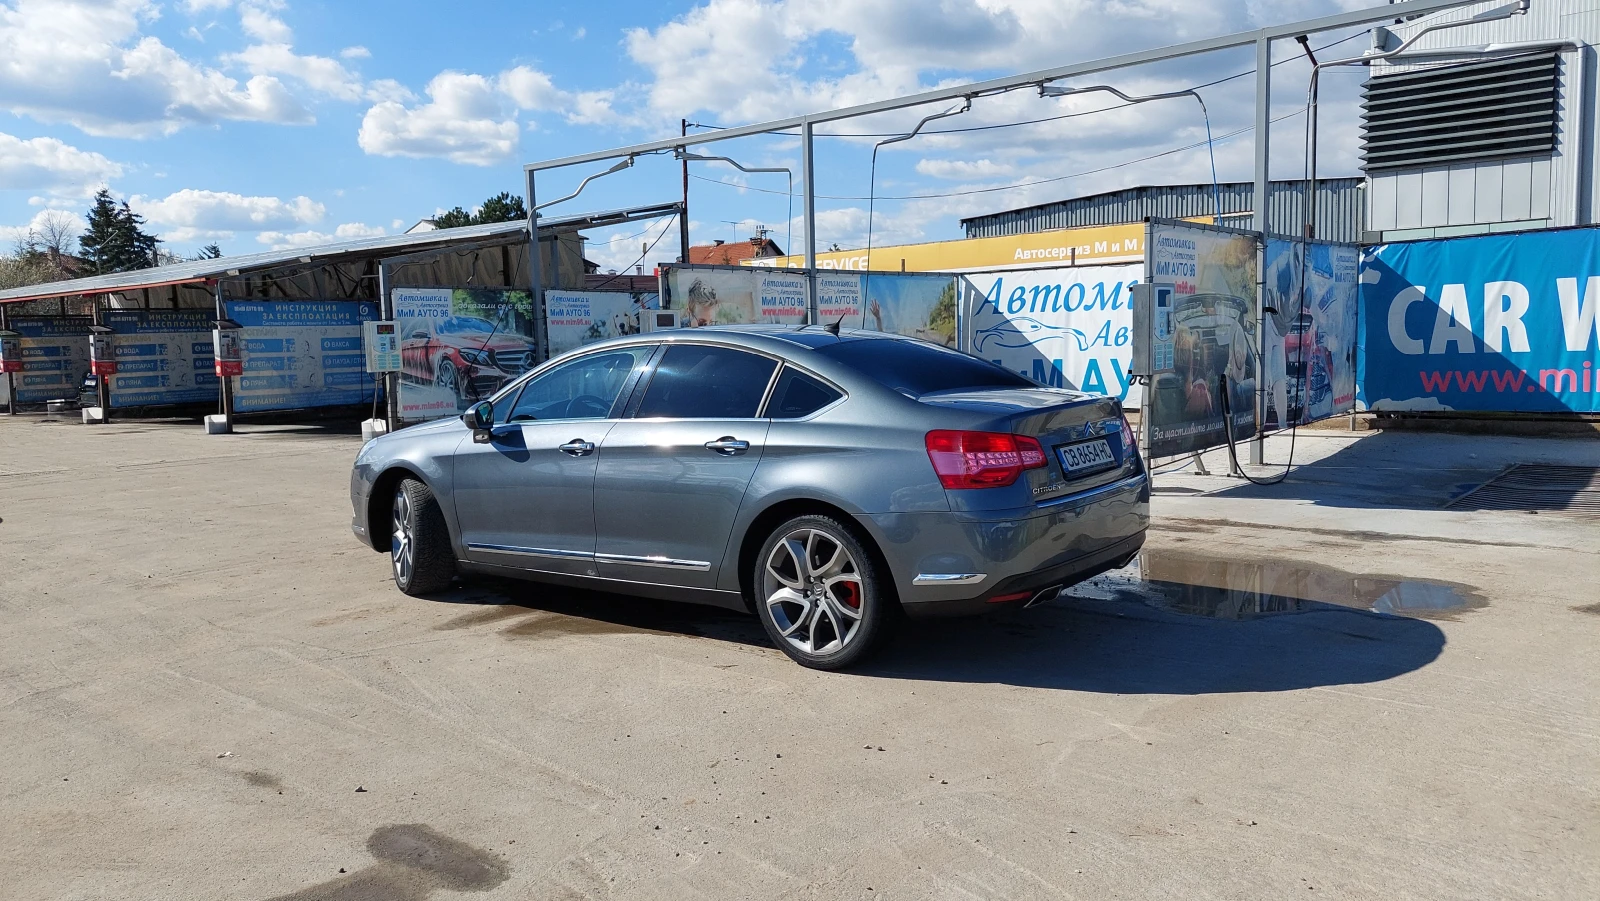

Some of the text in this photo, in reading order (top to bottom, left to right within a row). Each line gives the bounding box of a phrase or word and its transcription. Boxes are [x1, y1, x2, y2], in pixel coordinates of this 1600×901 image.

[778, 297, 795, 306] АУТО
[834, 296, 851, 305] АУТО
[275, 304, 337, 312] ИНСТРУКЦИЯ
[566, 308, 581, 316] АУТО
[148, 313, 207, 321] ИНСТРУКЦИЯ
[397, 309, 448, 317] МиМ АУТО 96
[1387, 280, 1531, 355] CAR
[1420, 361, 1600, 393] www.mi
